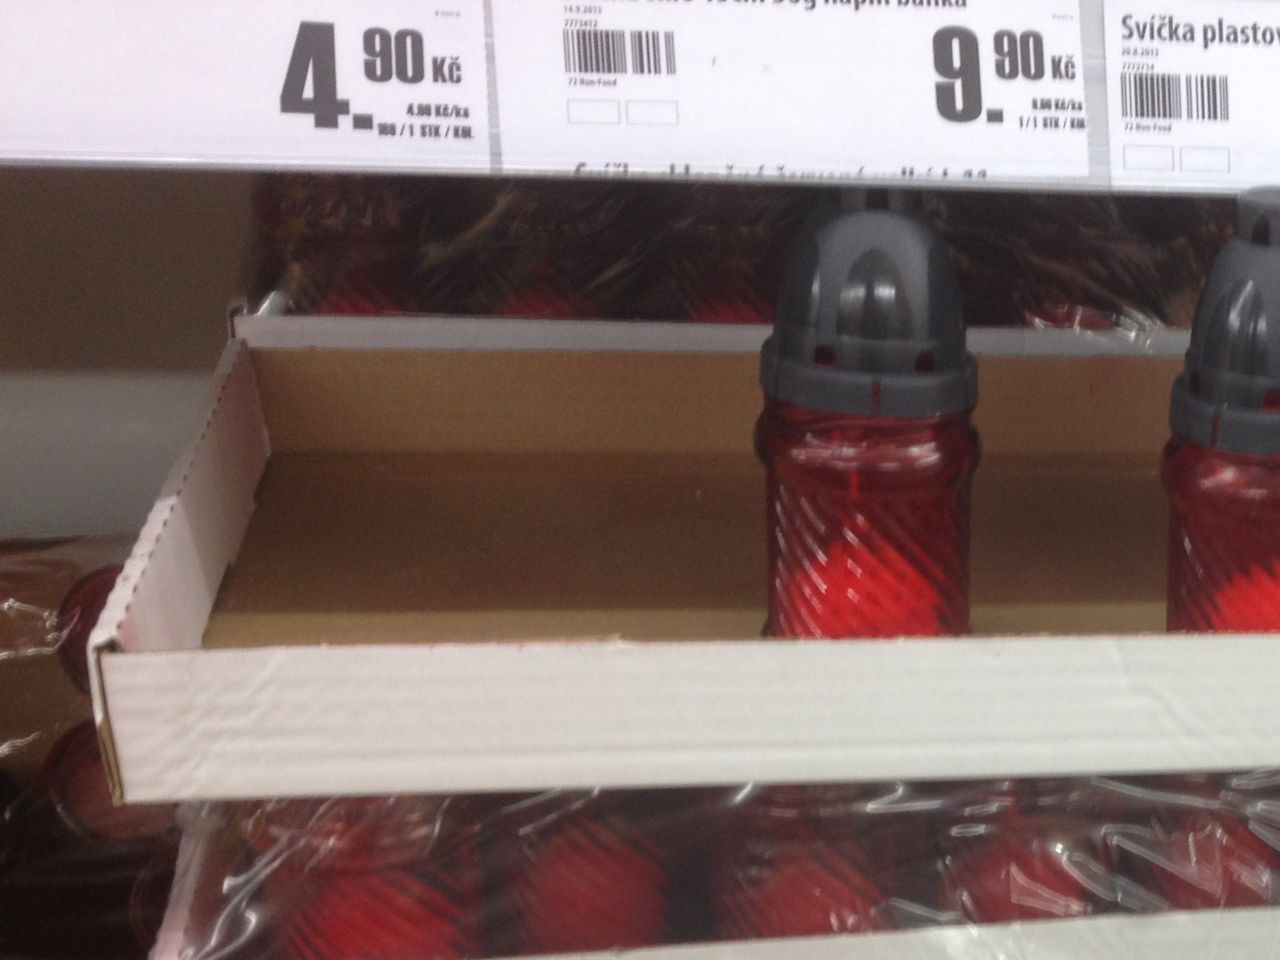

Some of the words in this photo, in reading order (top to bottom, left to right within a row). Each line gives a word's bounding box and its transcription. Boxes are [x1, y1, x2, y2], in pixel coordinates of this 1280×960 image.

[1121, 14, 1195, 42] Svíčka
[363, 27, 425, 84] 90
[432, 55, 462, 84] Kč
[993, 29, 1045, 81] 90
[1051, 55, 1077, 81] Kč
